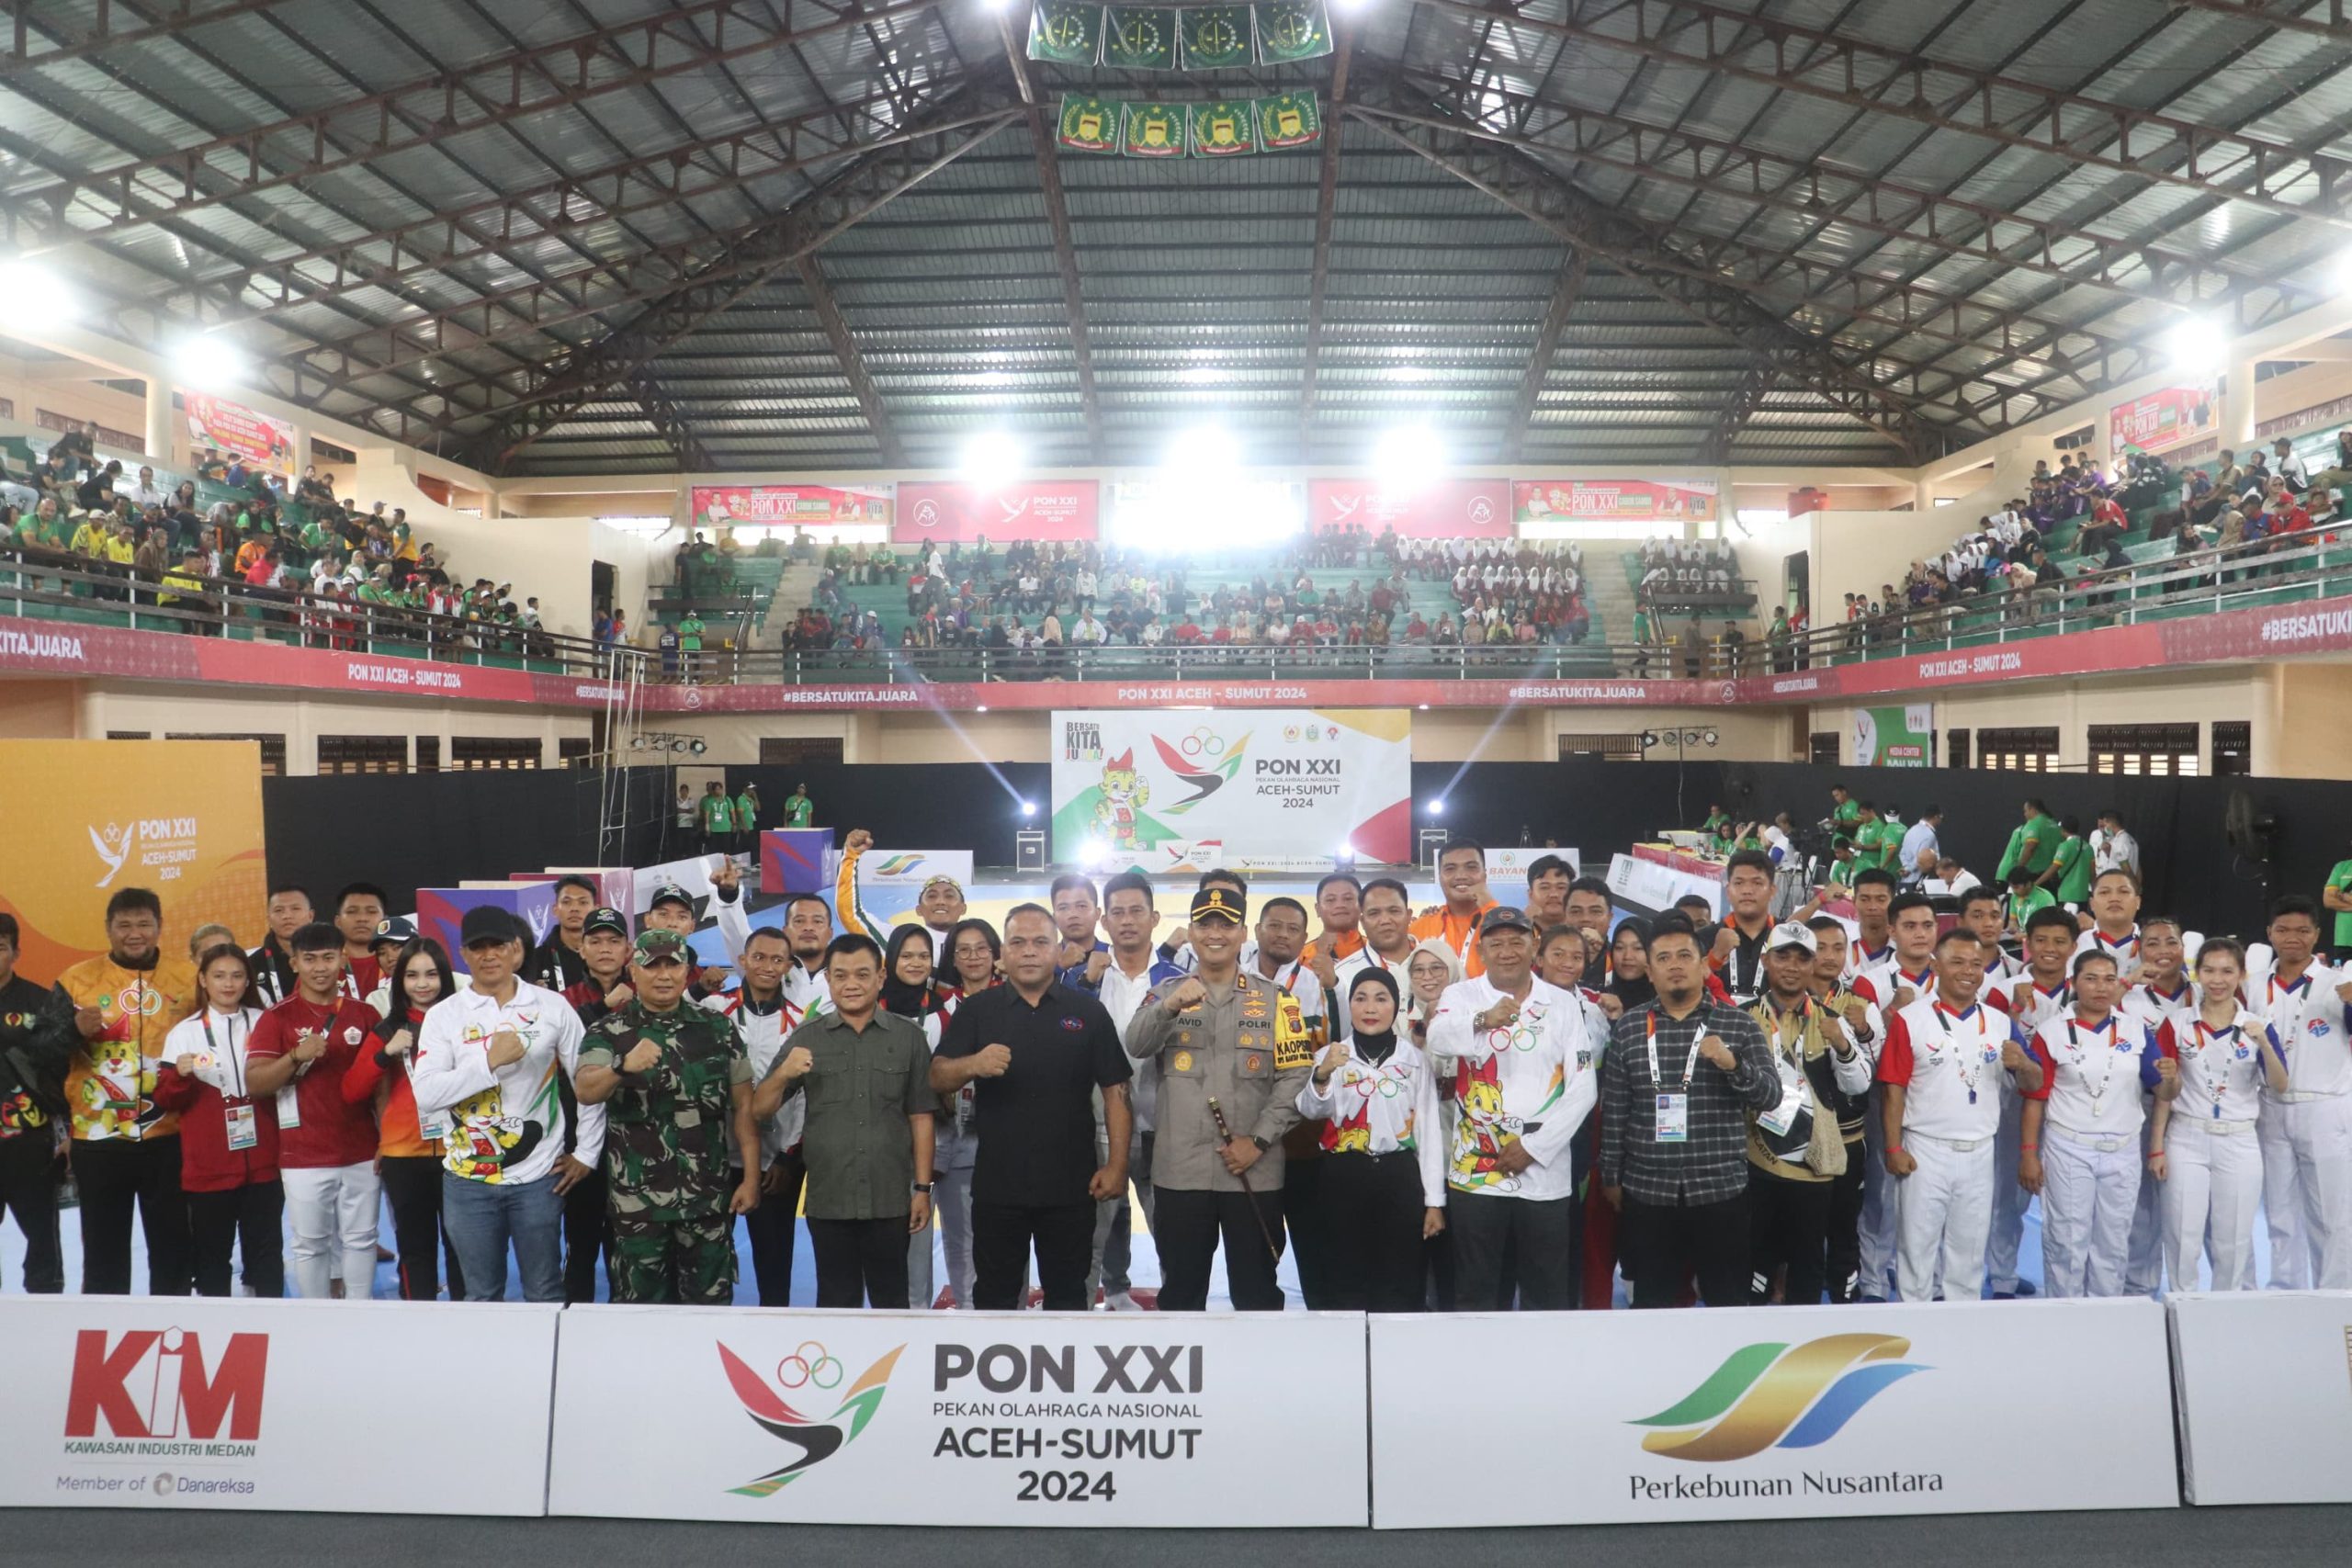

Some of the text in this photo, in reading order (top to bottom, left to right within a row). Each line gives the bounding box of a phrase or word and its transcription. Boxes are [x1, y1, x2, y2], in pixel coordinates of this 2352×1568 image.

[751, 499, 774, 514] PON
[777, 499, 797, 514] XXI
[1034, 496, 1078, 505] PON XXI
[1572, 494, 1595, 509] PON
[1599, 494, 1617, 509] XXI
[0, 631, 83, 660] ITAJUARA
[1919, 663, 1935, 679] PON
[1935, 660, 1947, 677] XXI
[1948, 659, 1967, 676] ACEH
[1973, 654, 2000, 673] SUMUT
[2001, 651, 2021, 670] 2024
[348, 663, 368, 682] PON
[369, 665, 384, 682] XXI
[386, 667, 409, 684] ACEH
[415, 670, 442, 687] SUMUT
[443, 673, 461, 688] 2024
[783, 690, 918, 703] #BERSATUKITAJUARA
[1118, 688, 1148, 700] PON
[1150, 688, 1172, 699] XXI
[1175, 687, 1212, 699] ACEH
[1225, 687, 1271, 699] SUMUT
[1274, 687, 1307, 699] 2024
[1509, 686, 1646, 698] #BERSATUKITAJUARA
[1066, 730, 1102, 750] KITA
[1889, 746, 1920, 757] MEDIA CENTER
[1255, 759, 1340, 775] PON XXI
[1256, 784, 1341, 795] ACEH-SUMUT
[1283, 797, 1315, 808] 2024
[139, 817, 198, 840] PON XXI
[141, 848, 198, 866] ACEH-SUMUT
[160, 866, 182, 881] 2024
[1488, 866, 1527, 875] BAYAN
[1177, 1017, 1203, 1028] AVID
[1238, 1020, 1271, 1029] POLRI
[1753, 1137, 1779, 1166] LATAN
[934, 1343, 1204, 1393] PON XXI
[933, 1402, 1203, 1418] PEKAN OLAHRAGA NASIONAL
[63, 1441, 256, 1458] KAWASAN INDUSTRI MEDAN
[933, 1427, 1203, 1461] ACEH-SUMUT
[55, 1475, 255, 1495] Member of Danareksa
[1016, 1470, 1117, 1502] 2024
[1630, 1470, 1944, 1500] Perkebunan Nusantara
